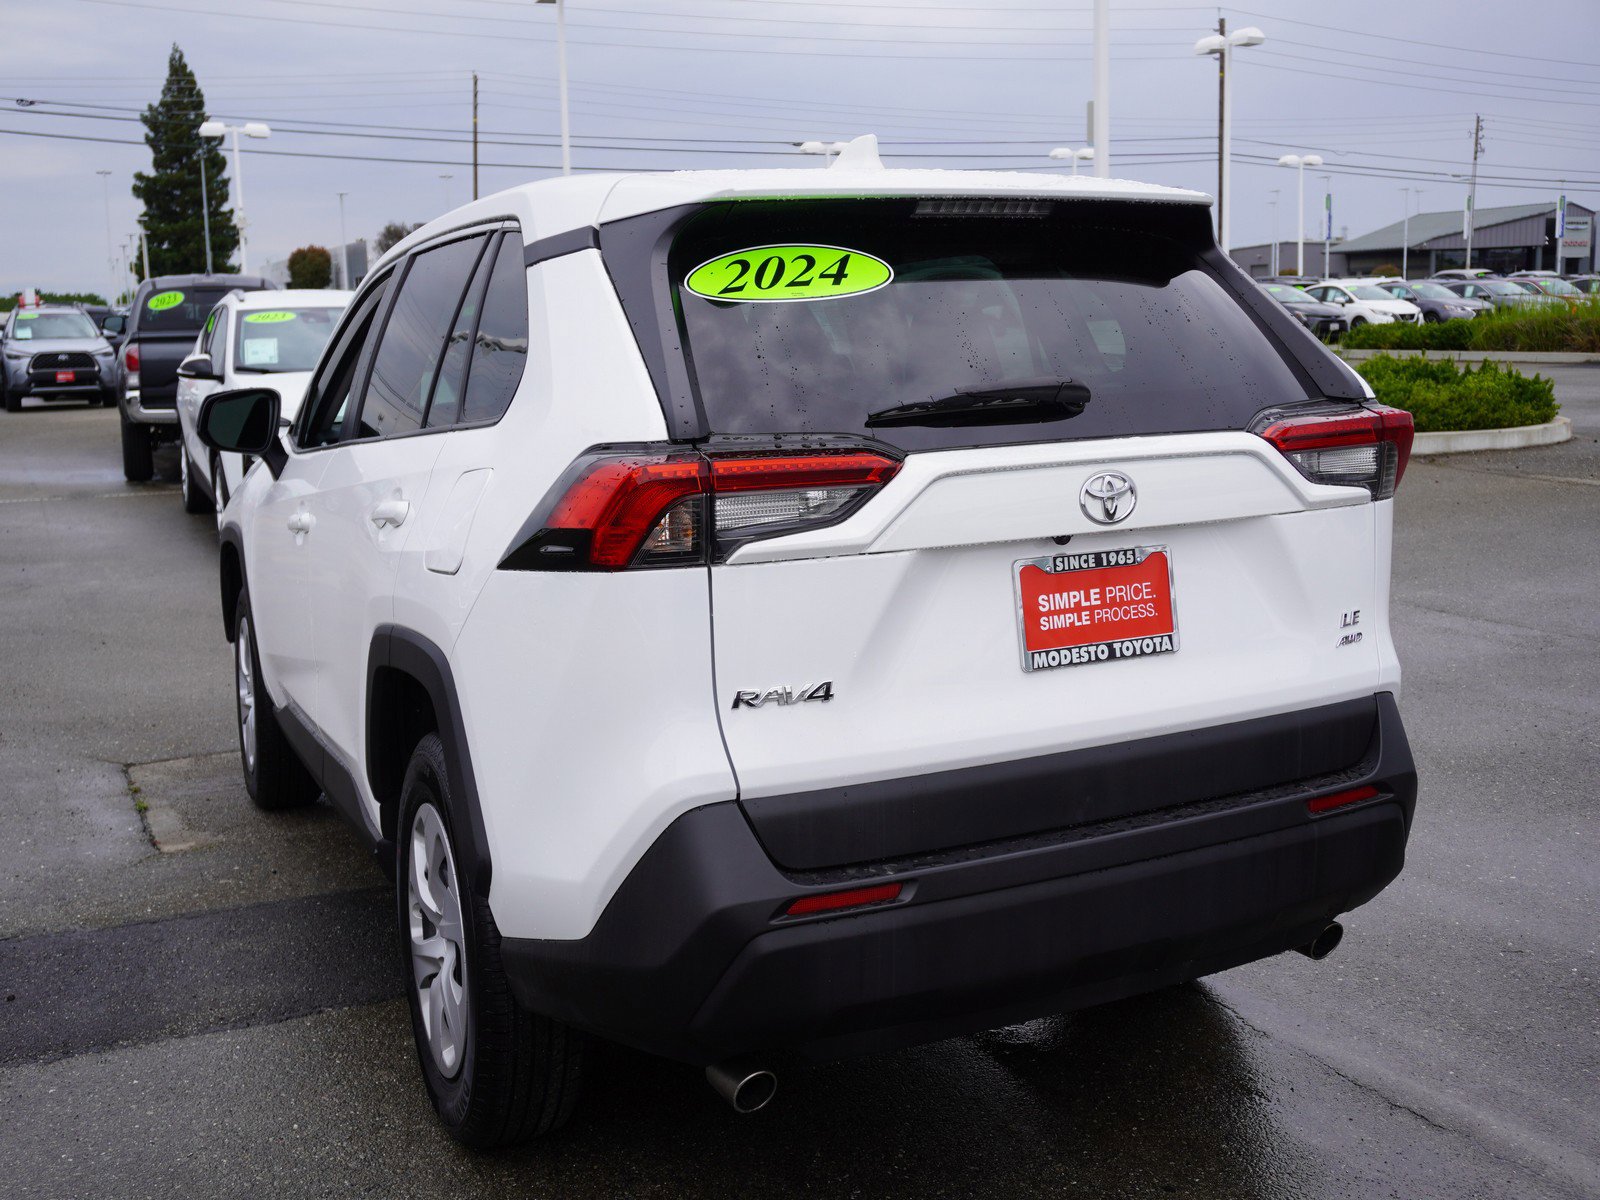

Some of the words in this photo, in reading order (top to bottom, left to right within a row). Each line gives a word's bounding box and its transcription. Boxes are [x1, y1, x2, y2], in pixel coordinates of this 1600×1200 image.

[717, 254, 851, 295] 2024
[1055, 554, 1096, 572] SINCE
[1100, 550, 1135, 567] 1965
[1037, 588, 1101, 612] SIMPLE
[1105, 582, 1157, 604] PRICE.
[1039, 611, 1091, 631] SIMPLE
[1094, 603, 1158, 623] PROCESS.
[1340, 609, 1361, 629] LE
[1033, 644, 1109, 669] MODESTO
[1113, 635, 1173, 658] TOYOTA
[731, 680, 834, 711] RAV4
